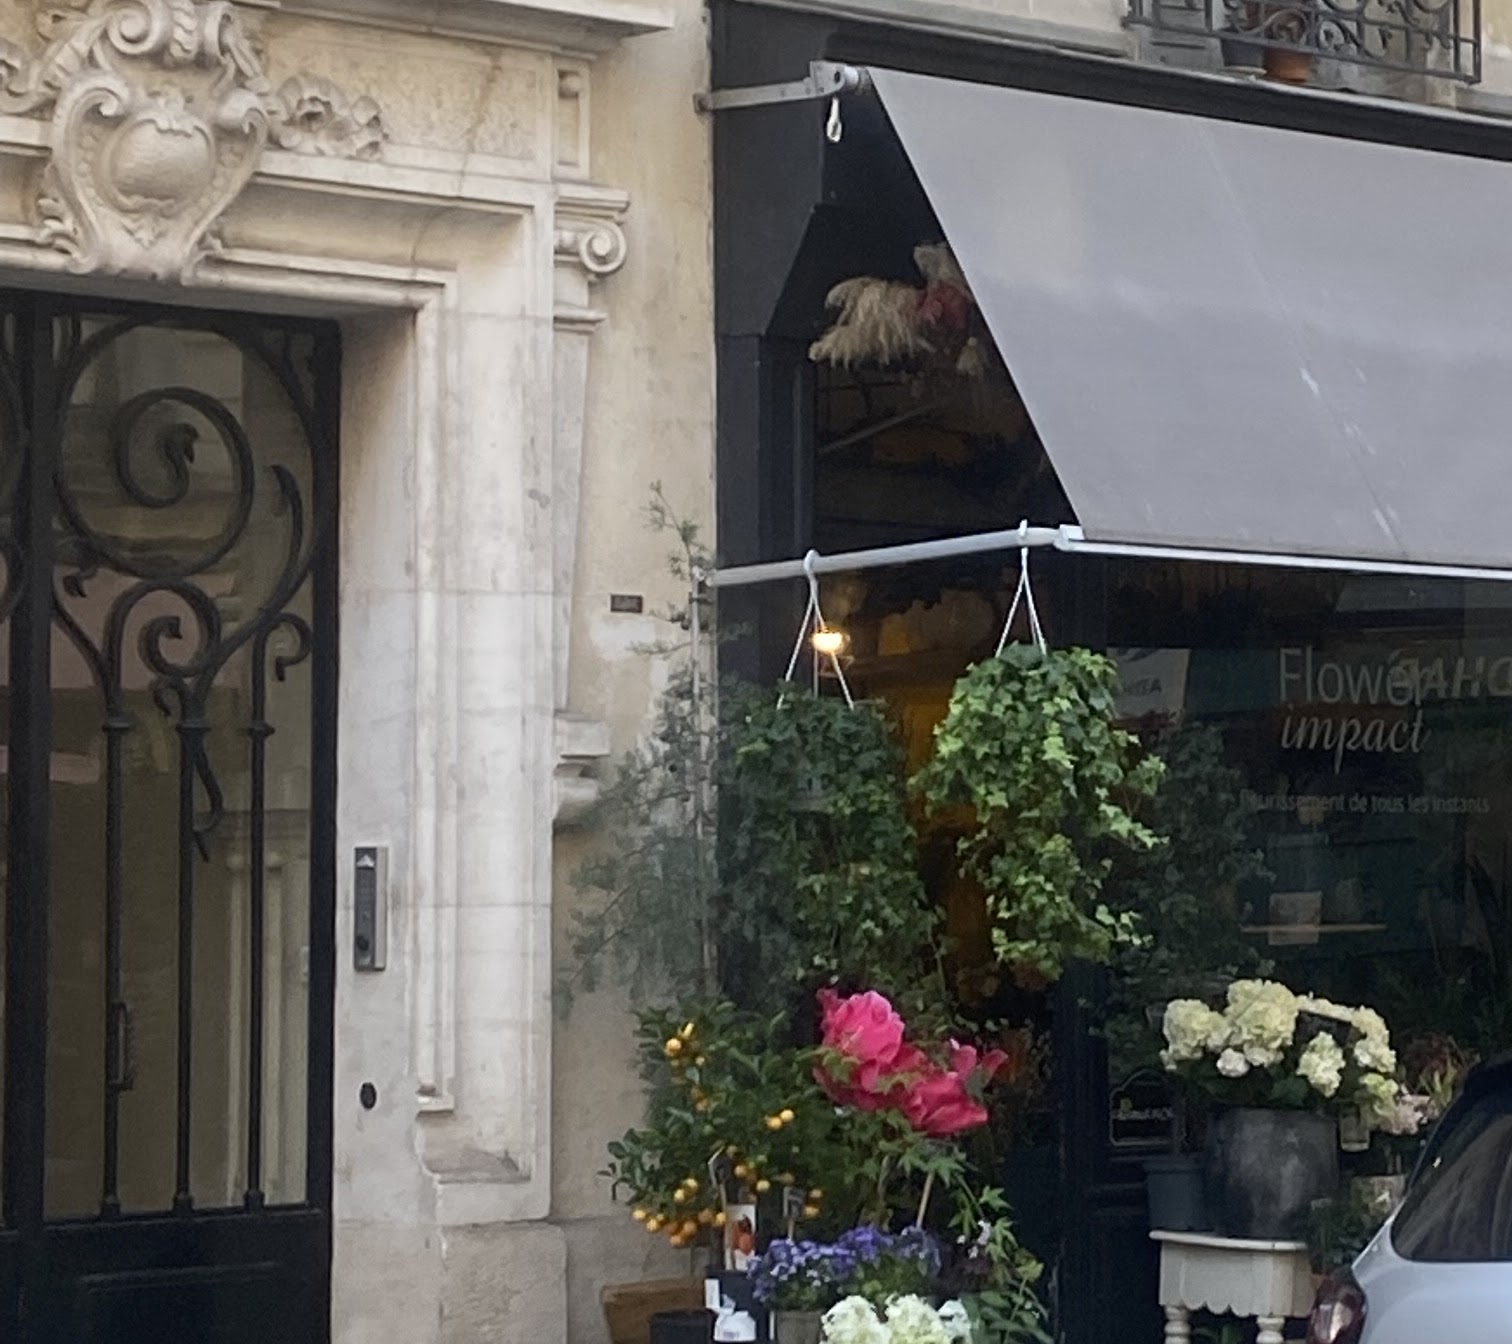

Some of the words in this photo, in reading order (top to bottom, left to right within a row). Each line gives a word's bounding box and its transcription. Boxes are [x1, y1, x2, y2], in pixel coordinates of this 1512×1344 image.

[1279, 644, 1430, 707] Flower
[1280, 705, 1431, 775] impact
[1348, 792, 1368, 813] de
